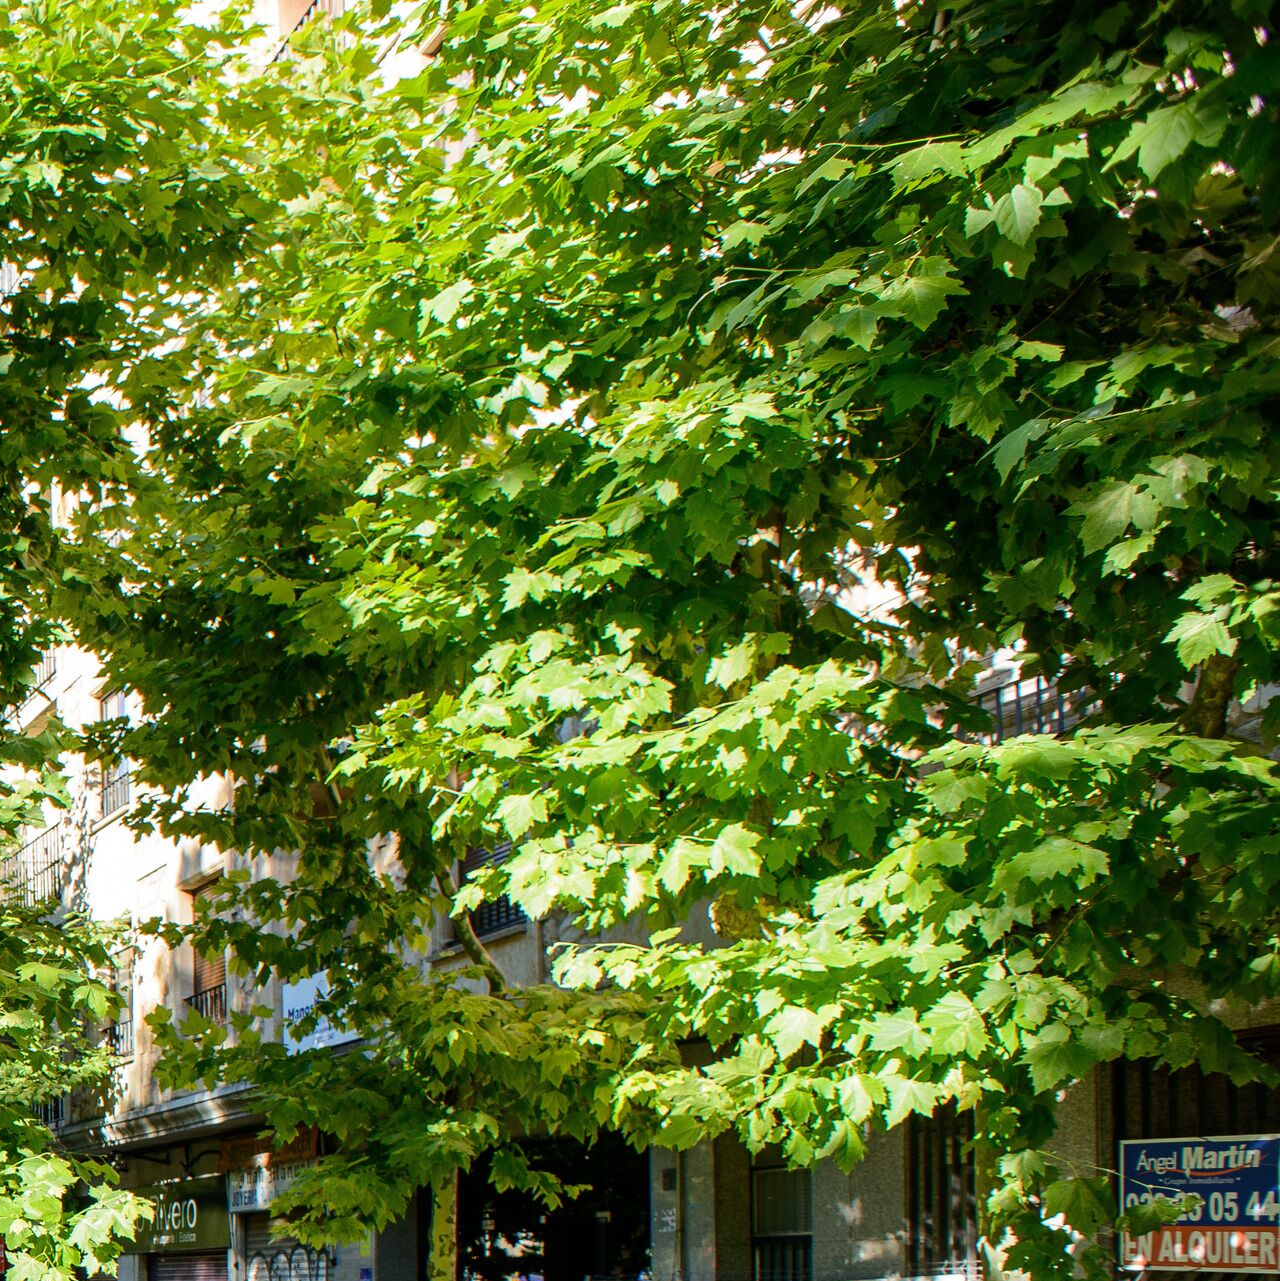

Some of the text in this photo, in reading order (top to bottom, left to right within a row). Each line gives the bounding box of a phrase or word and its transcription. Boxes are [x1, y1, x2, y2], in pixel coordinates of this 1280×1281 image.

[1136, 1144, 1261, 1175] Ángel Martín
[149, 1194, 197, 1231] Rivero
[1209, 1191, 1239, 1222] 05
[1245, 1191, 1278, 1221] 44
[1124, 1230, 1276, 1266] EN ALQUILER
